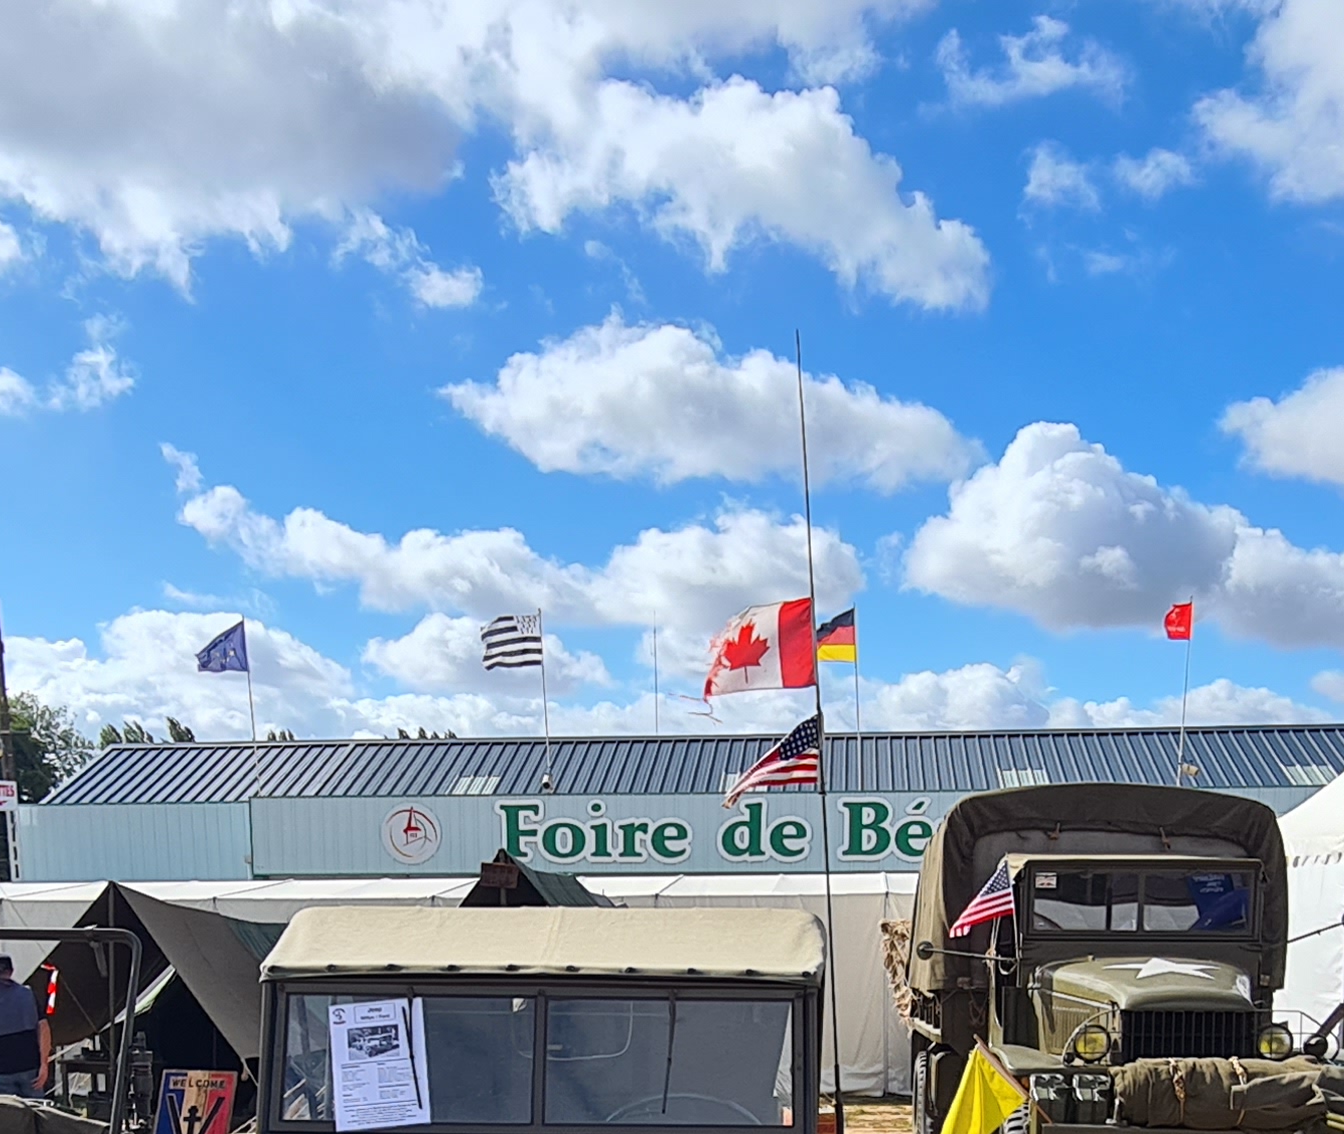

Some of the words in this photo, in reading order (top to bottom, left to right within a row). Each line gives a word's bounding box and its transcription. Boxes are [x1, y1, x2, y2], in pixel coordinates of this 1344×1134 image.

[498, 801, 691, 860] Foire
[721, 800, 809, 860] de
[840, 800, 934, 858] Bé
[171, 1077, 227, 1089] WELCOME
